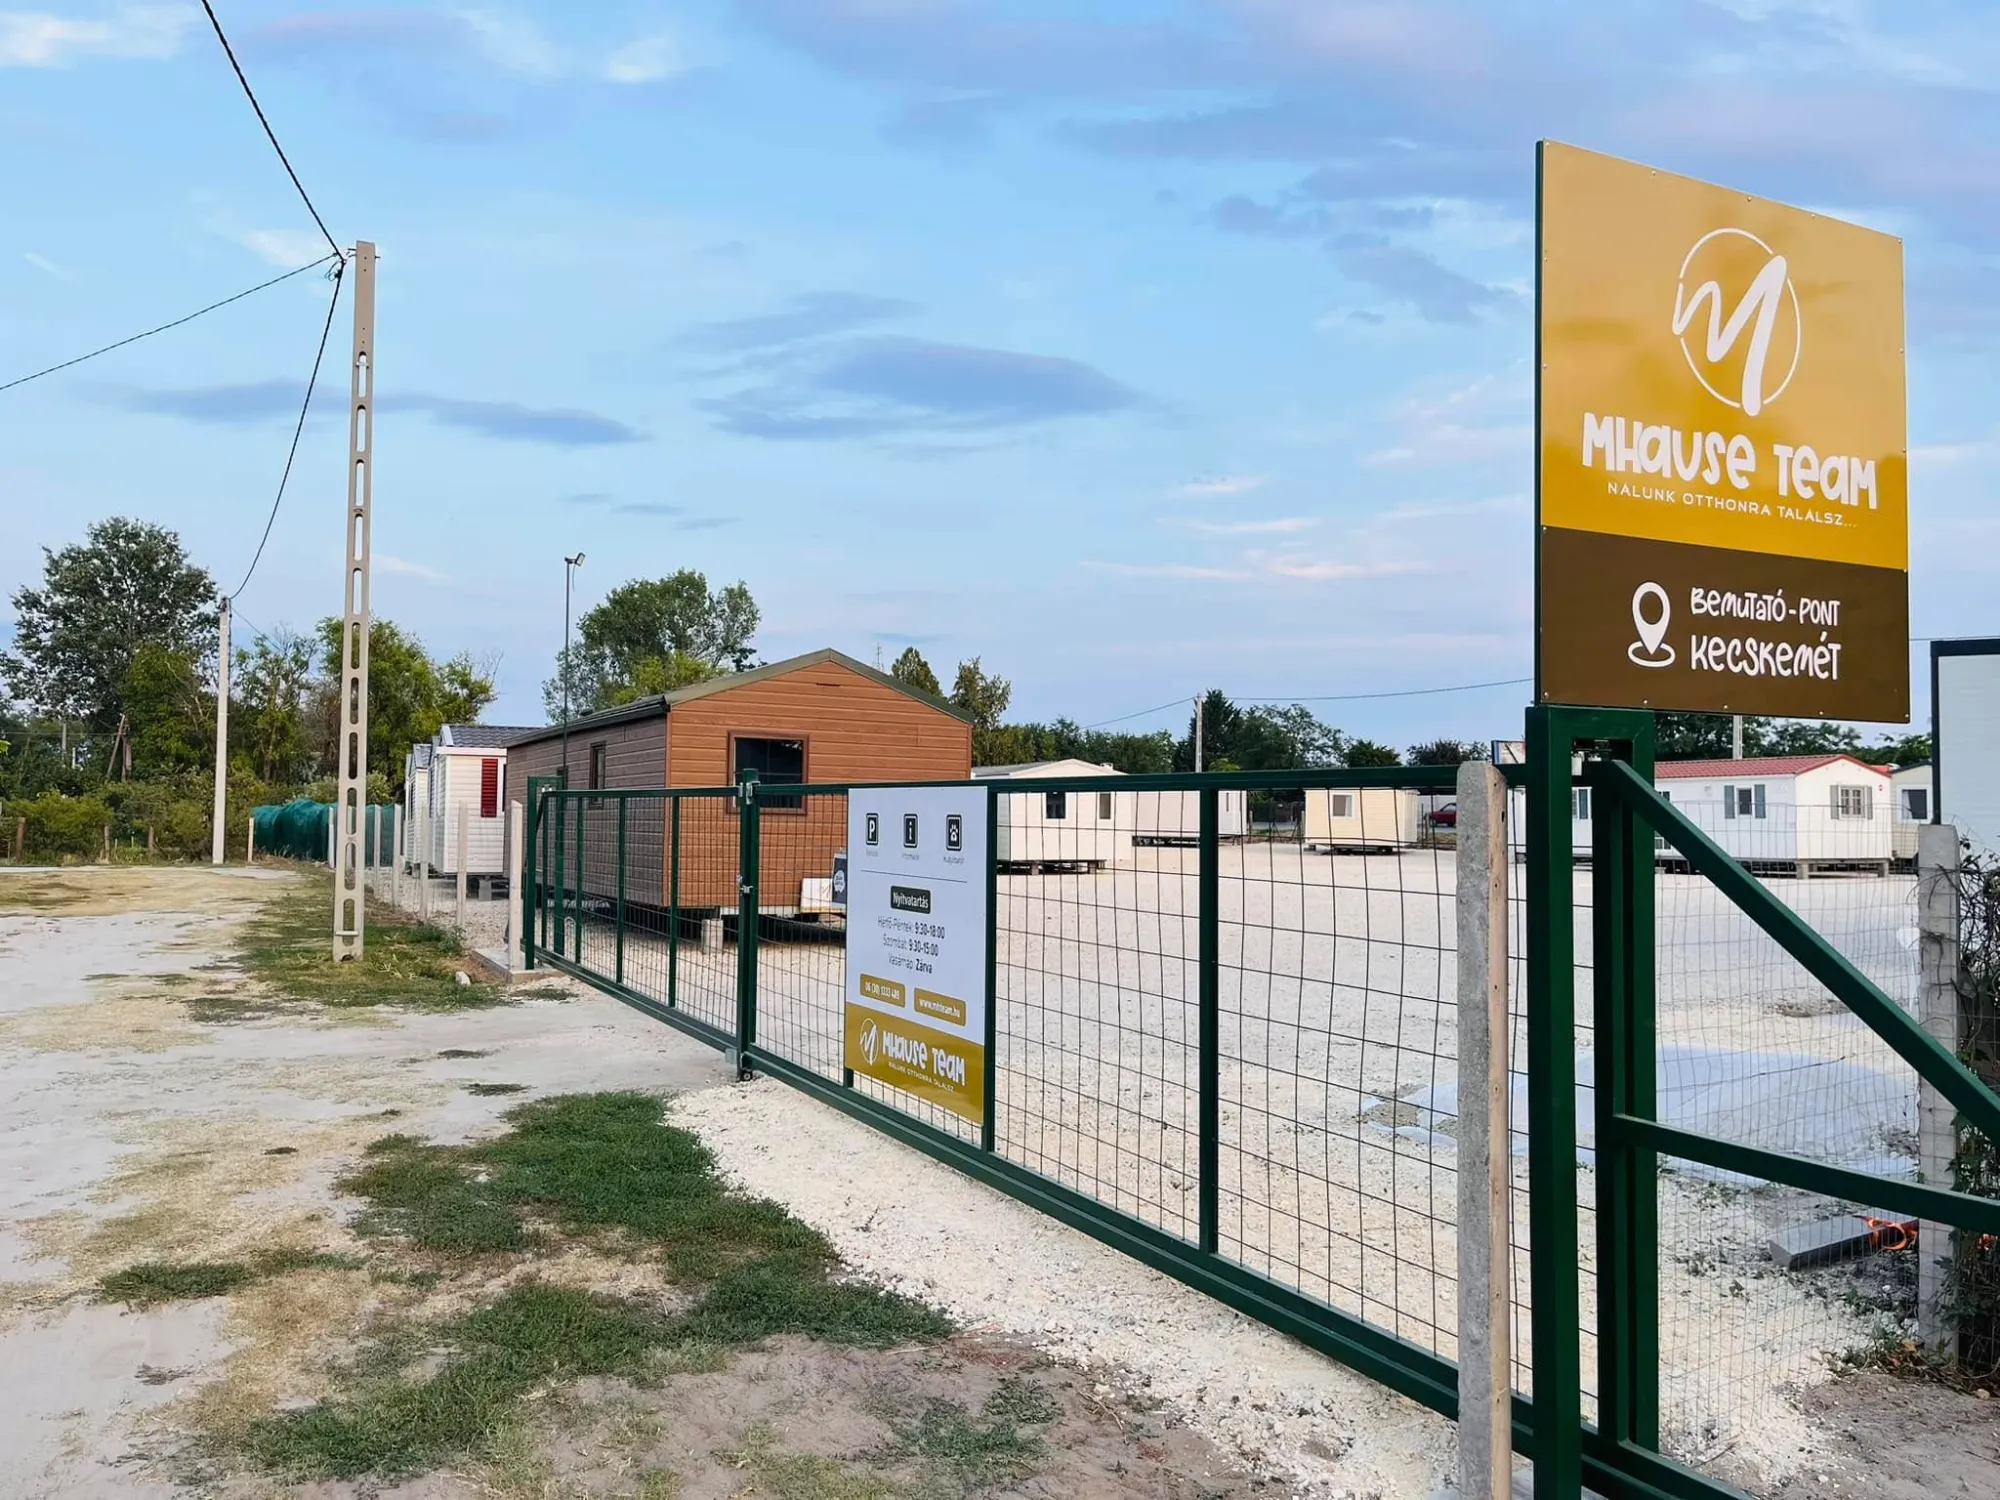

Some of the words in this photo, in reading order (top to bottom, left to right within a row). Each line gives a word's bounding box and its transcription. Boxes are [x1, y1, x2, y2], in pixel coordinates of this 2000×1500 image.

[1607, 482, 1676, 504] NALUNK
[1682, 492, 1771, 516] OTTHONRA
[1690, 631, 1842, 680] Kecskemét
[915, 958, 933, 974] Zárva
